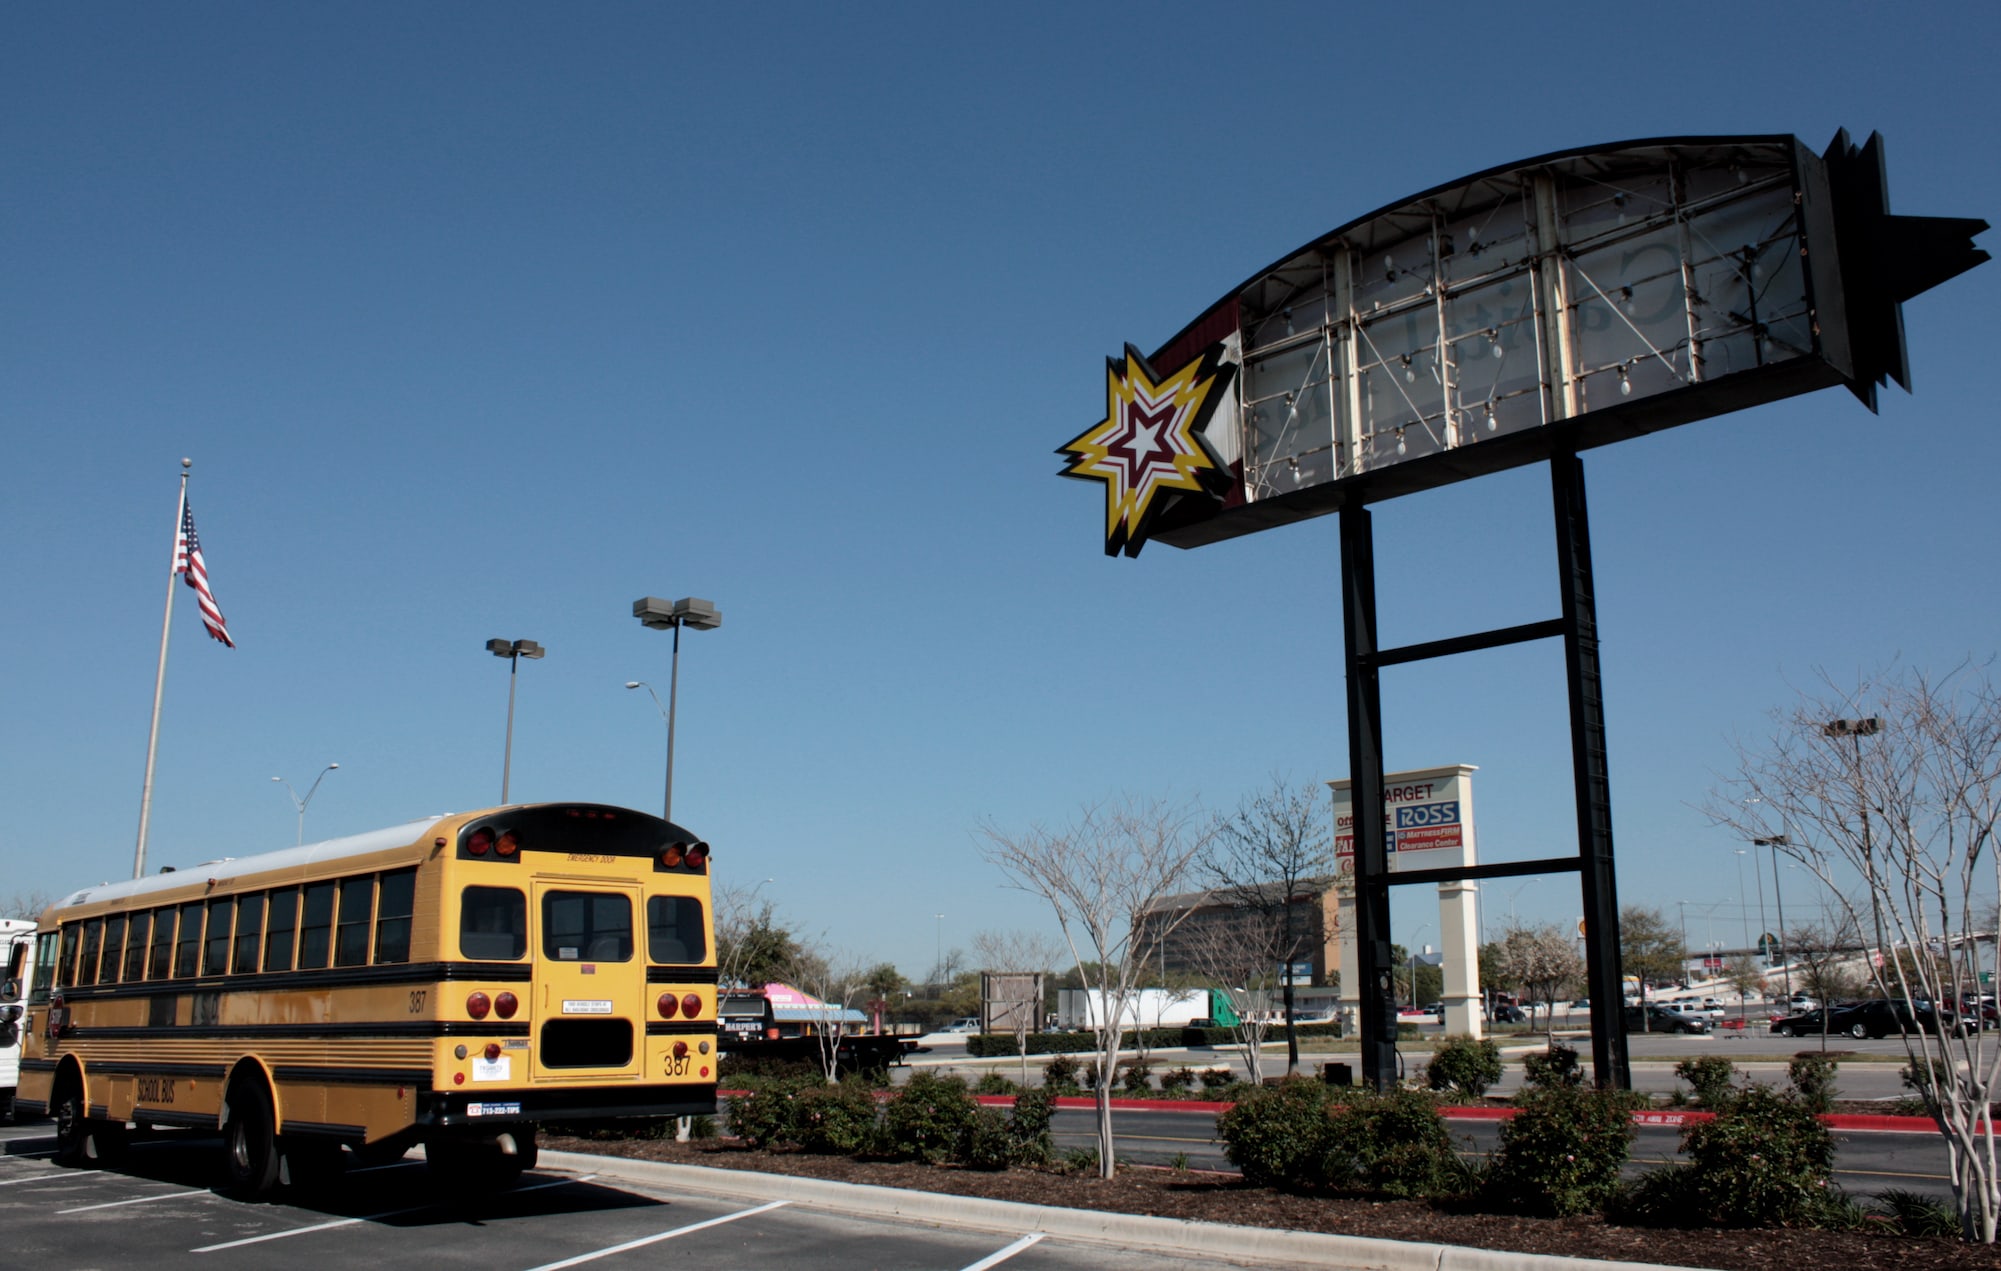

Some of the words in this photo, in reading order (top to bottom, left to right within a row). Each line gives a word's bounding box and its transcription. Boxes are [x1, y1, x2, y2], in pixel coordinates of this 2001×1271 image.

[1383, 784, 1434, 803] ARGET
[1401, 804, 1455, 826] ROSS
[1434, 839, 1459, 847] Center
[409, 990, 426, 1014] 387
[664, 1055, 691, 1076] 387
[137, 1078, 160, 1103] SCHOOL
[161, 1079, 175, 1104] BUS
